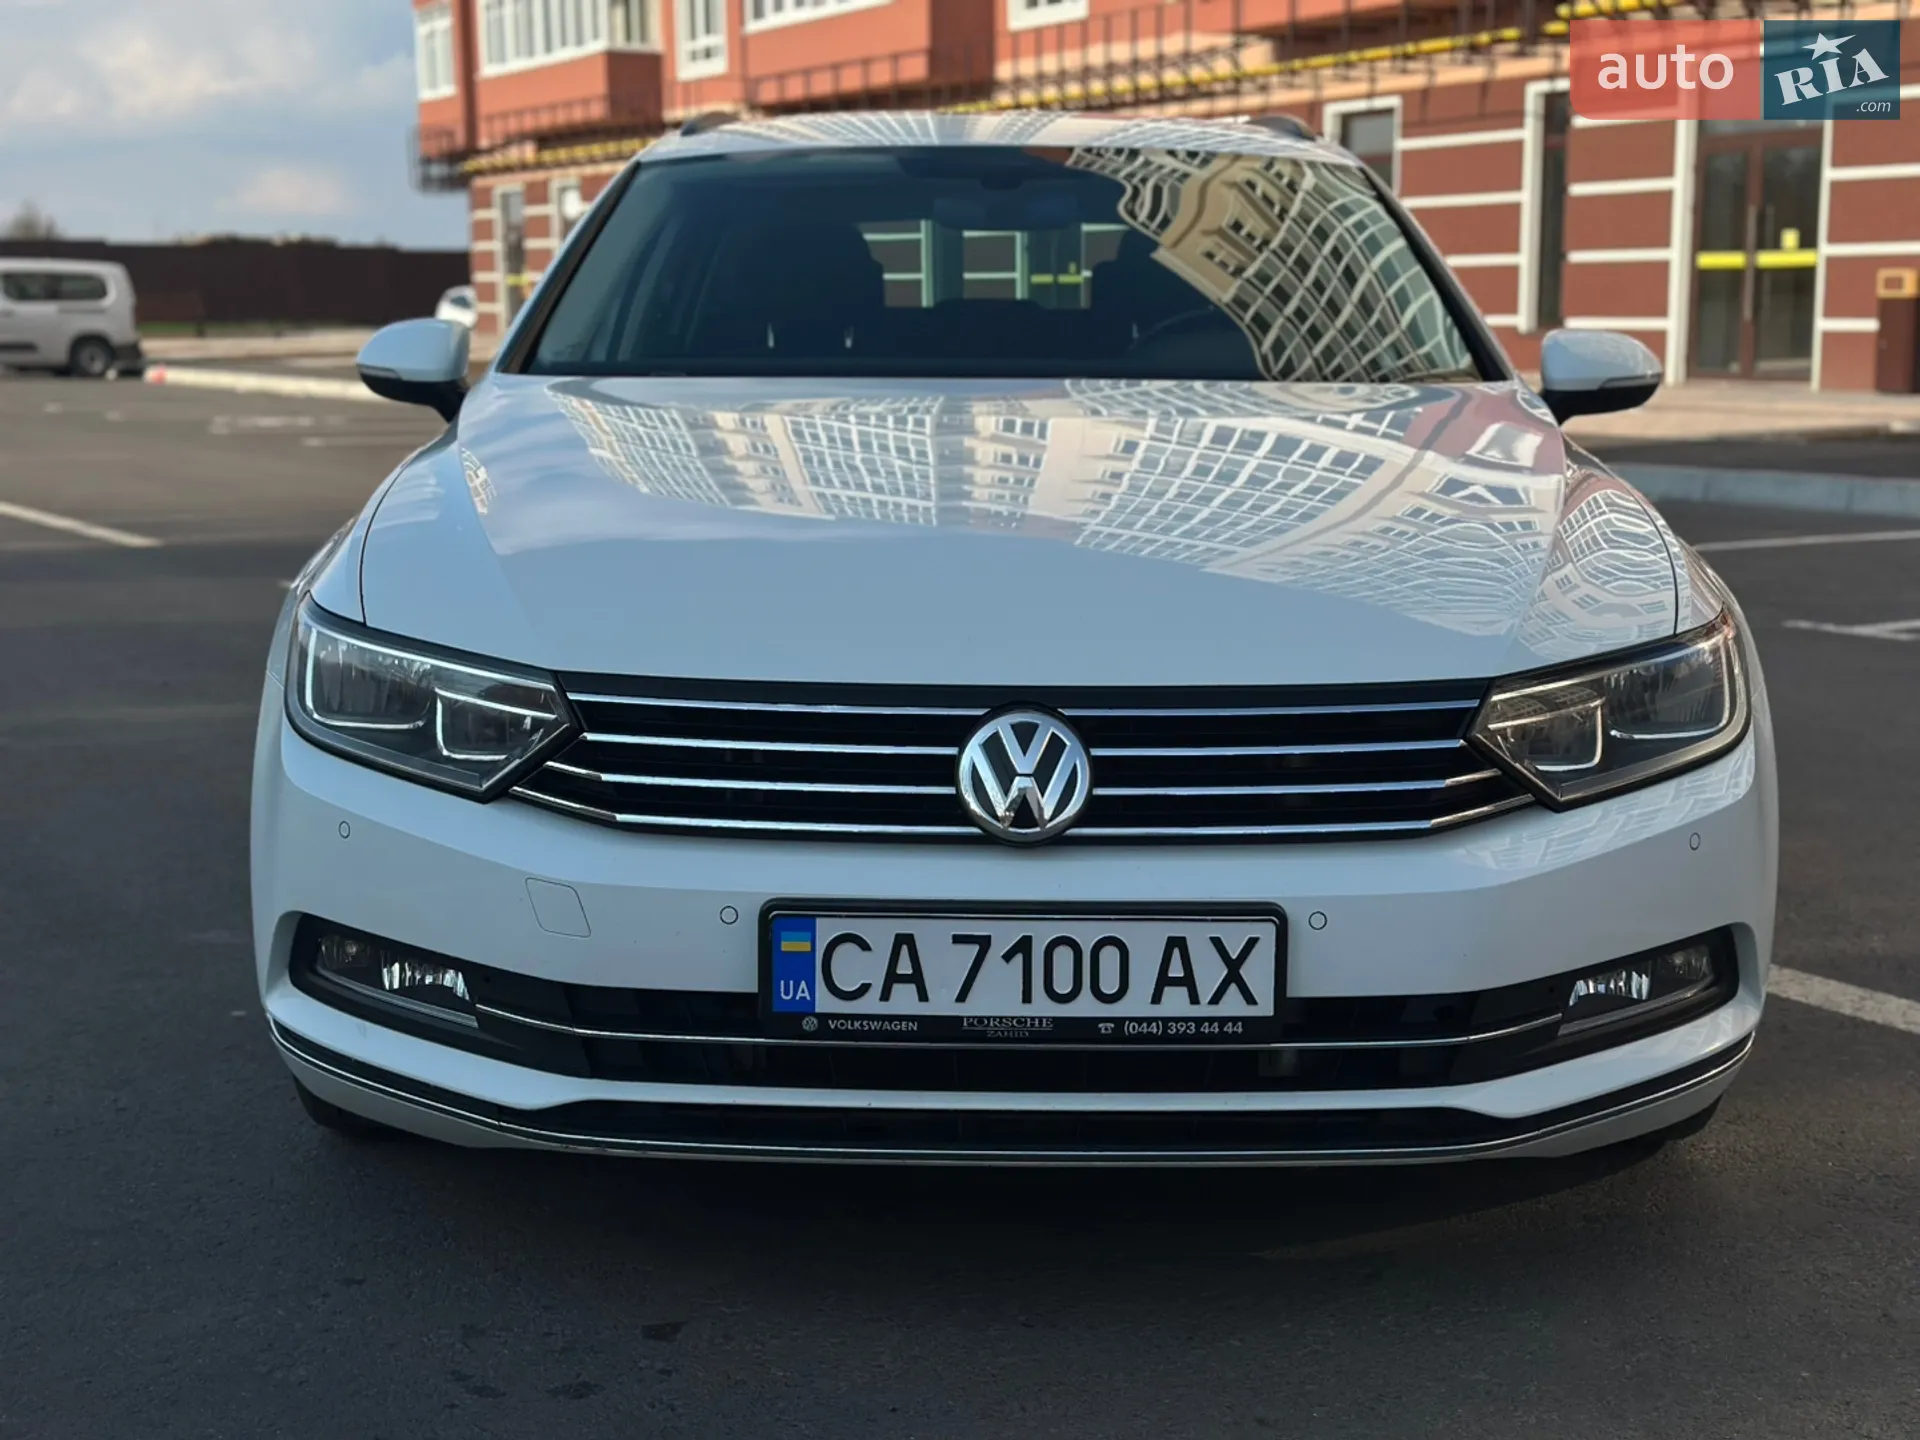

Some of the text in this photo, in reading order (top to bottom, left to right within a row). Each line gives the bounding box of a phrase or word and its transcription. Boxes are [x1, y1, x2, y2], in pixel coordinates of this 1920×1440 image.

[821, 931, 1261, 1005] CA 7100 AX
[780, 979, 811, 1000] UA
[828, 1019, 918, 1031] VOLKSWAGEN
[962, 1017, 1054, 1028] PORSCHE
[1124, 1020, 1243, 1036] (044) 393 44 44
